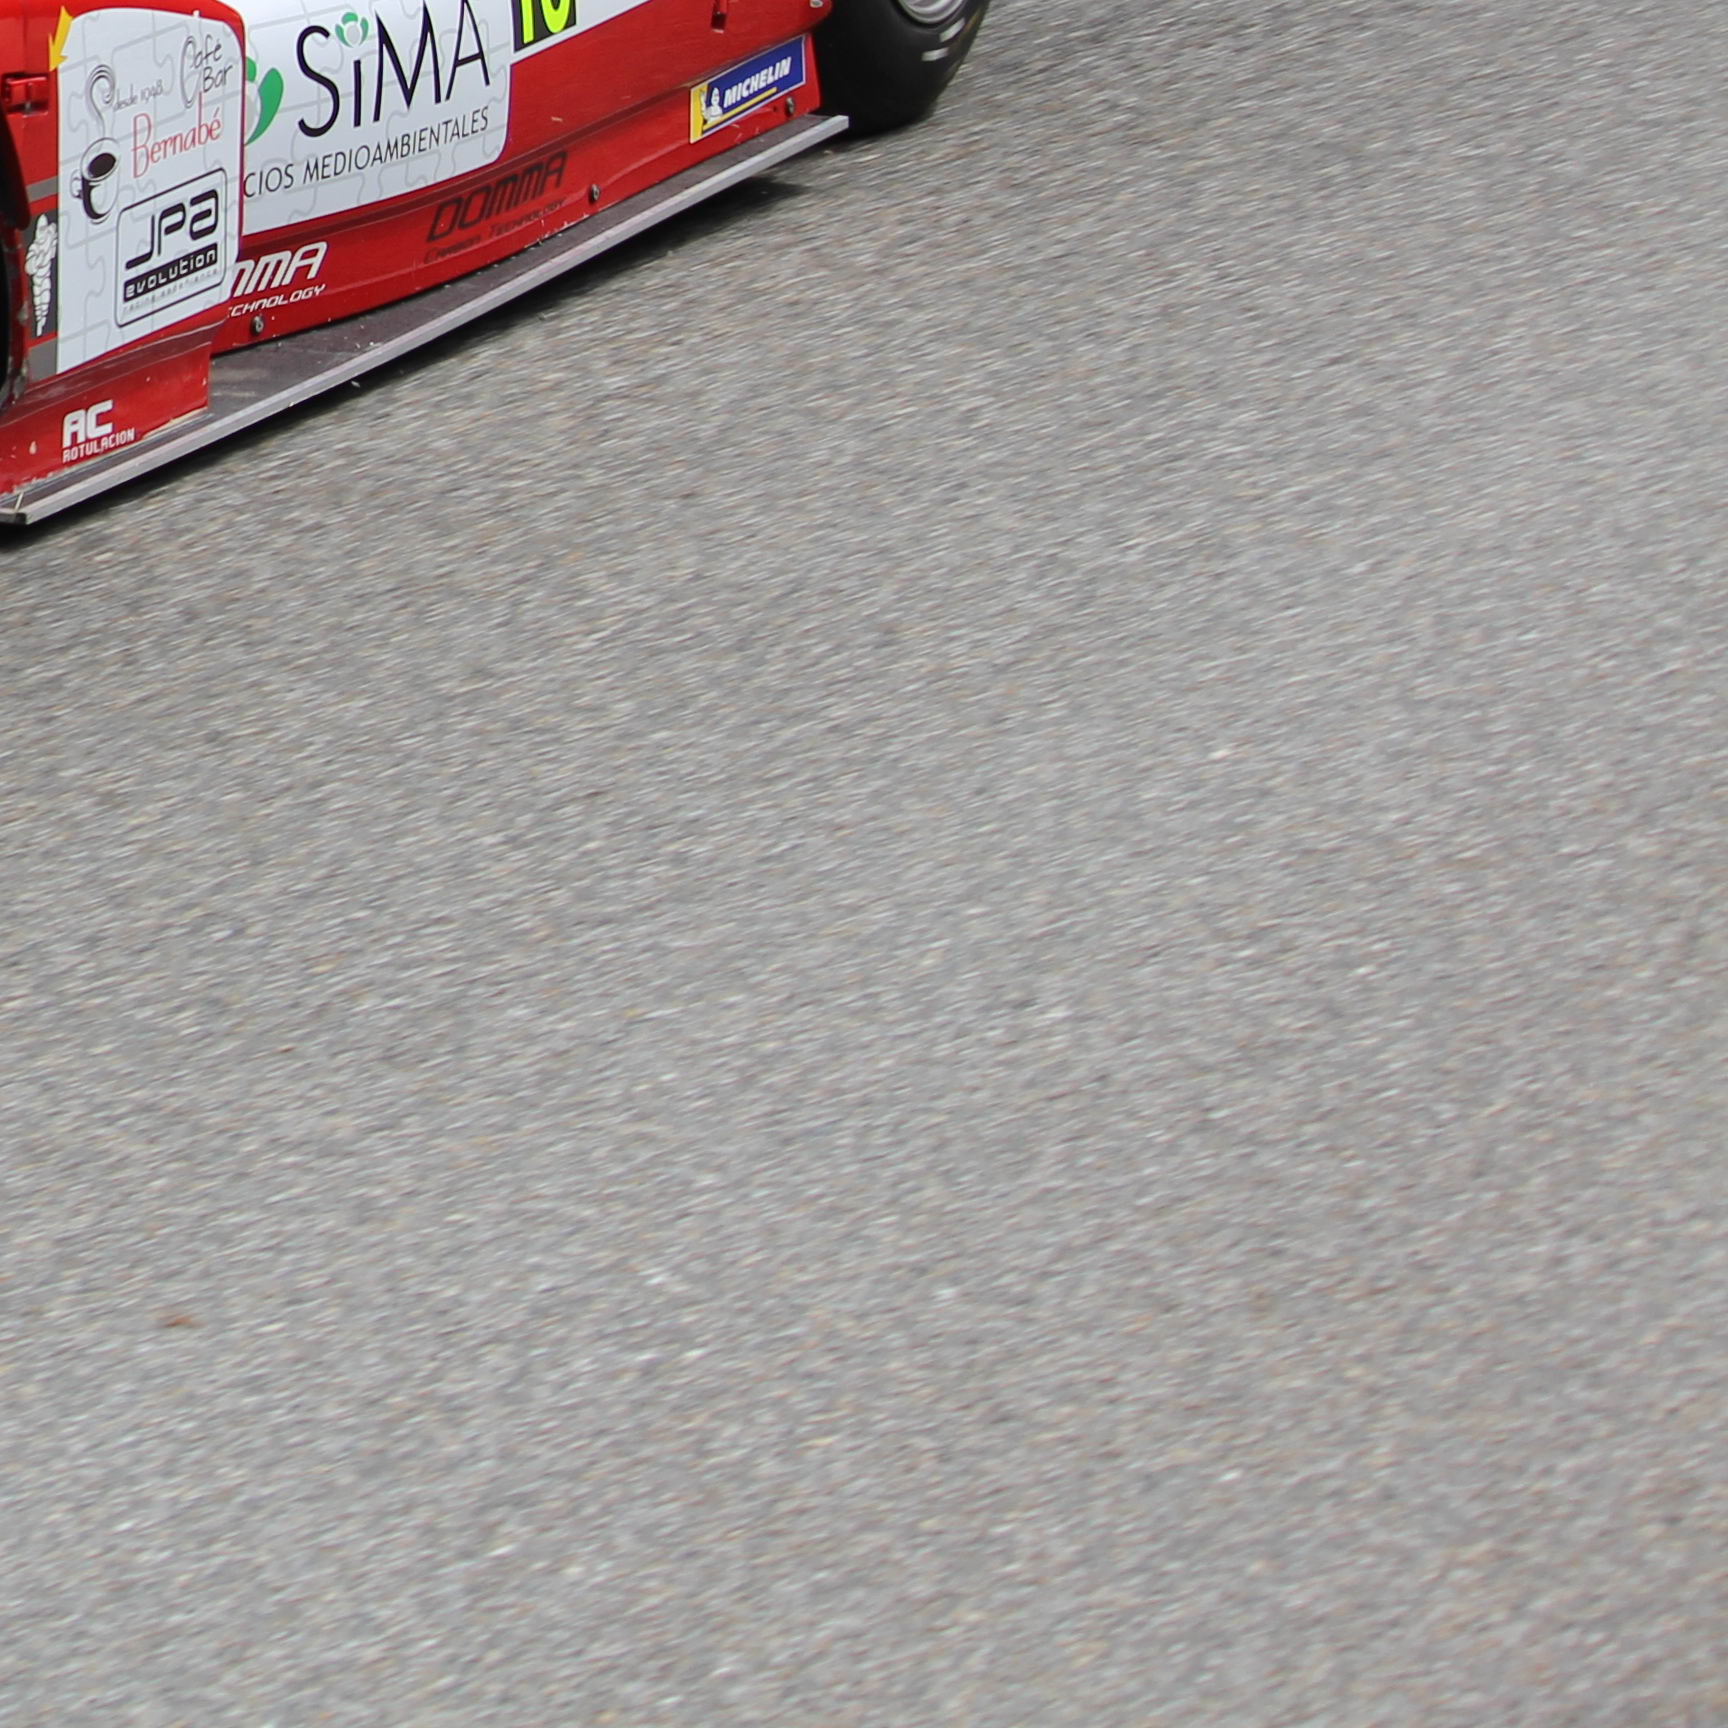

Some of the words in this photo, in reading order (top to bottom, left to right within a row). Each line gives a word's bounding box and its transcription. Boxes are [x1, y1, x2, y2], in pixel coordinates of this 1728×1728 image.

[180, 34, 223, 109] Café
[202, 64, 234, 94] Bar
[724, 56, 791, 108] MICHELIN
[131, 92, 223, 179] Bernabé
[303, 106, 490, 185] MEDIOAMBIENTALES
[426, 151, 570, 244] DOMMA
[126, 248, 217, 298] evolution
[228, 283, 327, 319] CHNOLOGY
[62, 399, 114, 448] AC
[62, 427, 136, 463] ROTULACION
